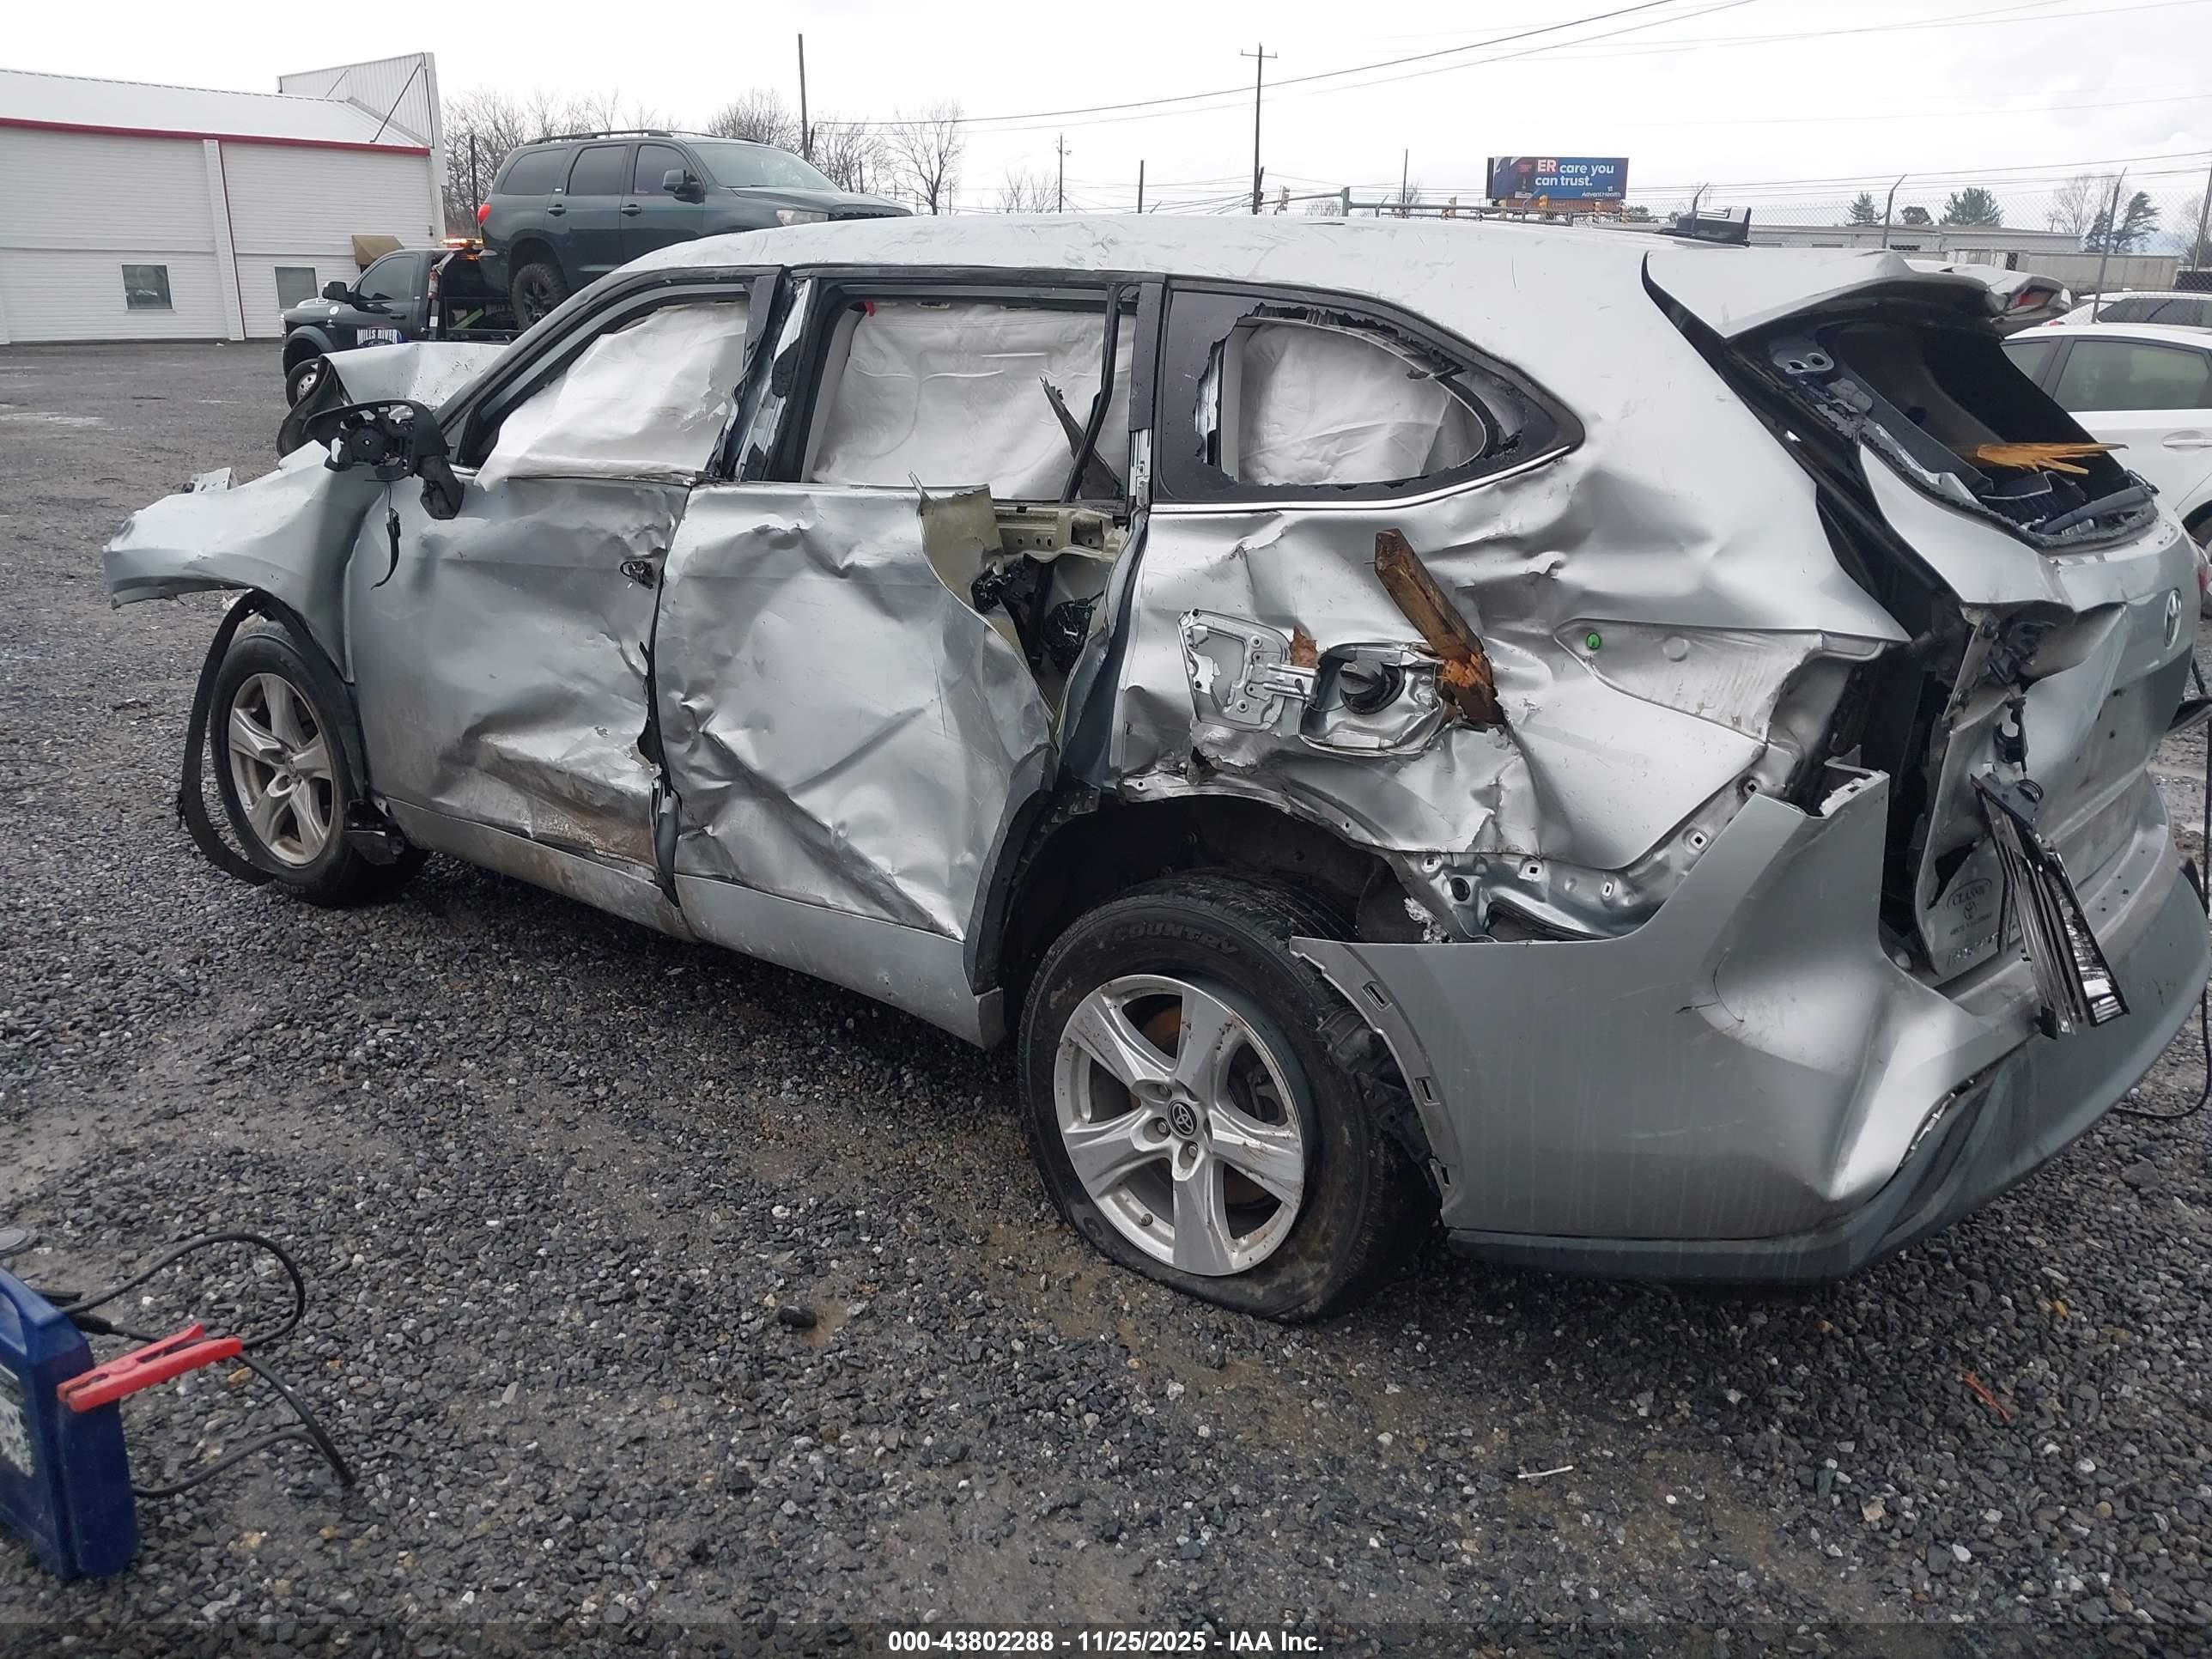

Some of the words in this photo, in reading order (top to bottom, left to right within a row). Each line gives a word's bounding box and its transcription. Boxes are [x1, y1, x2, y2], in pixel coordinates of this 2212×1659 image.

[1537, 160, 1556, 172] ER
[1559, 163, 1588, 173] care
[1590, 163, 1614, 177] you
[1534, 175, 1558, 186] can
[1560, 175, 1593, 186] trust.
[357, 330, 376, 345] MILLS
[378, 330, 398, 343] RIVER
